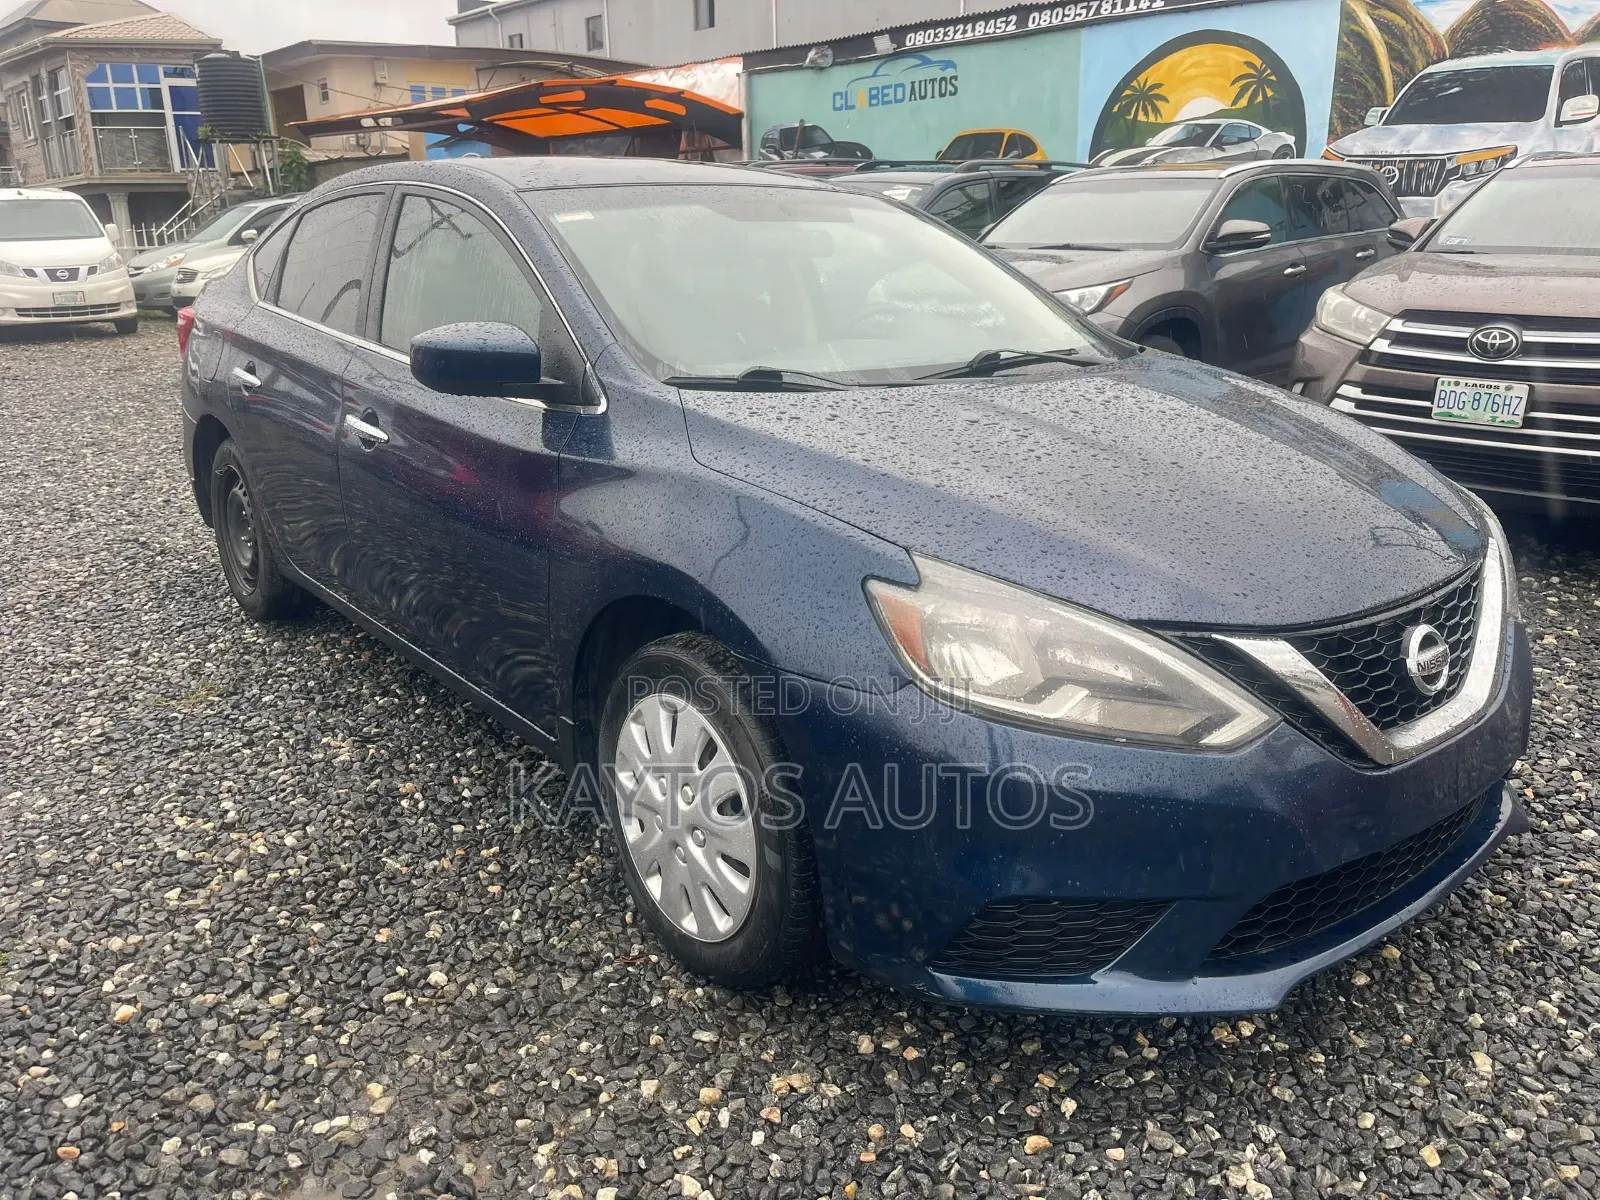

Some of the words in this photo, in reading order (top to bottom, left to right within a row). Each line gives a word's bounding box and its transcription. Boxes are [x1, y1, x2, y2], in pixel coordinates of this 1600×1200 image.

[905, 15, 1017, 47] 08033218452
[832, 82, 906, 112] CLABED
[907, 75, 959, 102] AUTOS
[1464, 382, 1501, 390] LAGOS
[1437, 389, 1524, 417] BDG-876HZ
